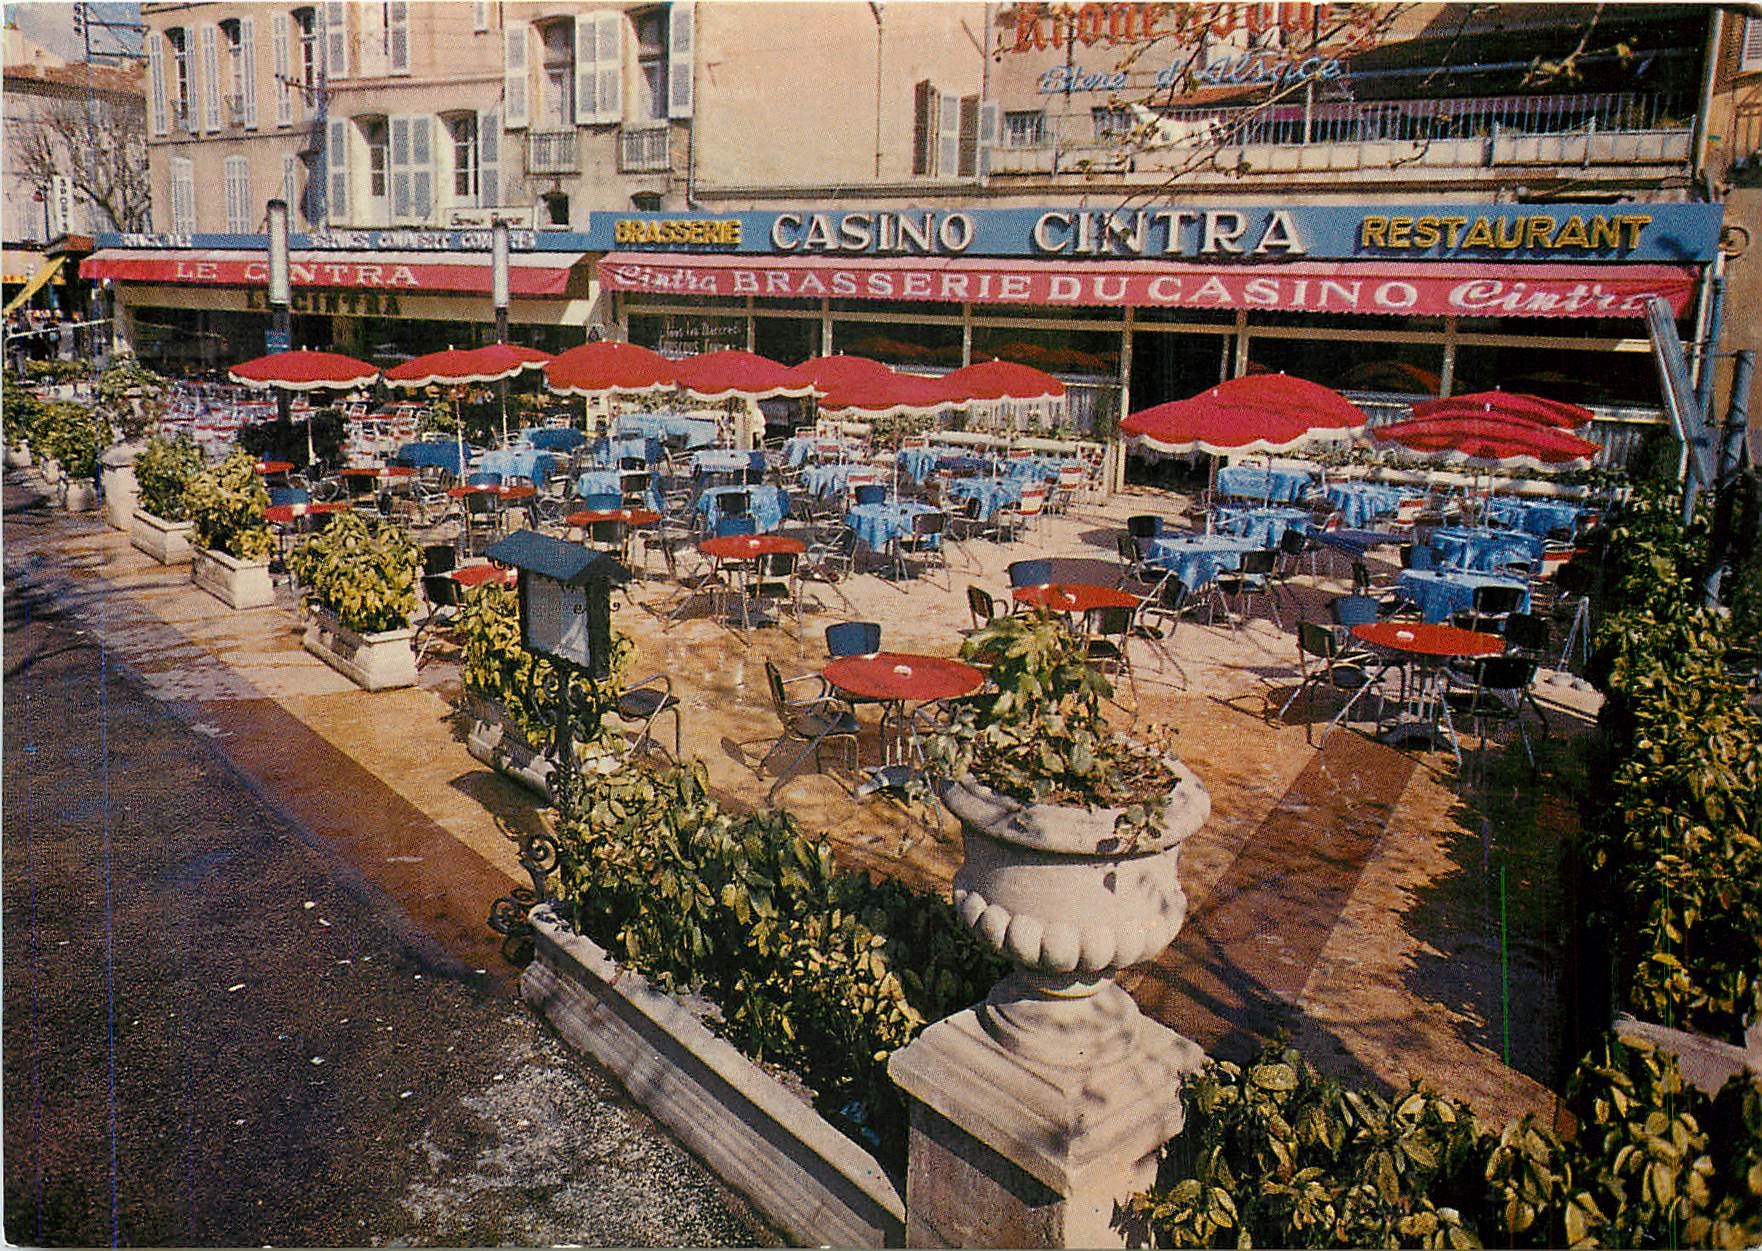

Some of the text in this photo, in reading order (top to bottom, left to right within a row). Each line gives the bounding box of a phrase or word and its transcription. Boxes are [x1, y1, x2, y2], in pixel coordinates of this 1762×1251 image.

[615, 219, 743, 245] BRASSERIE
[771, 210, 1308, 256] CASINO CINTRA
[1361, 214, 1653, 250] RESTAURANT
[176, 261, 420, 287] LE CNTRA
[733, 269, 1418, 309] BRASSERIE DU CASINO
